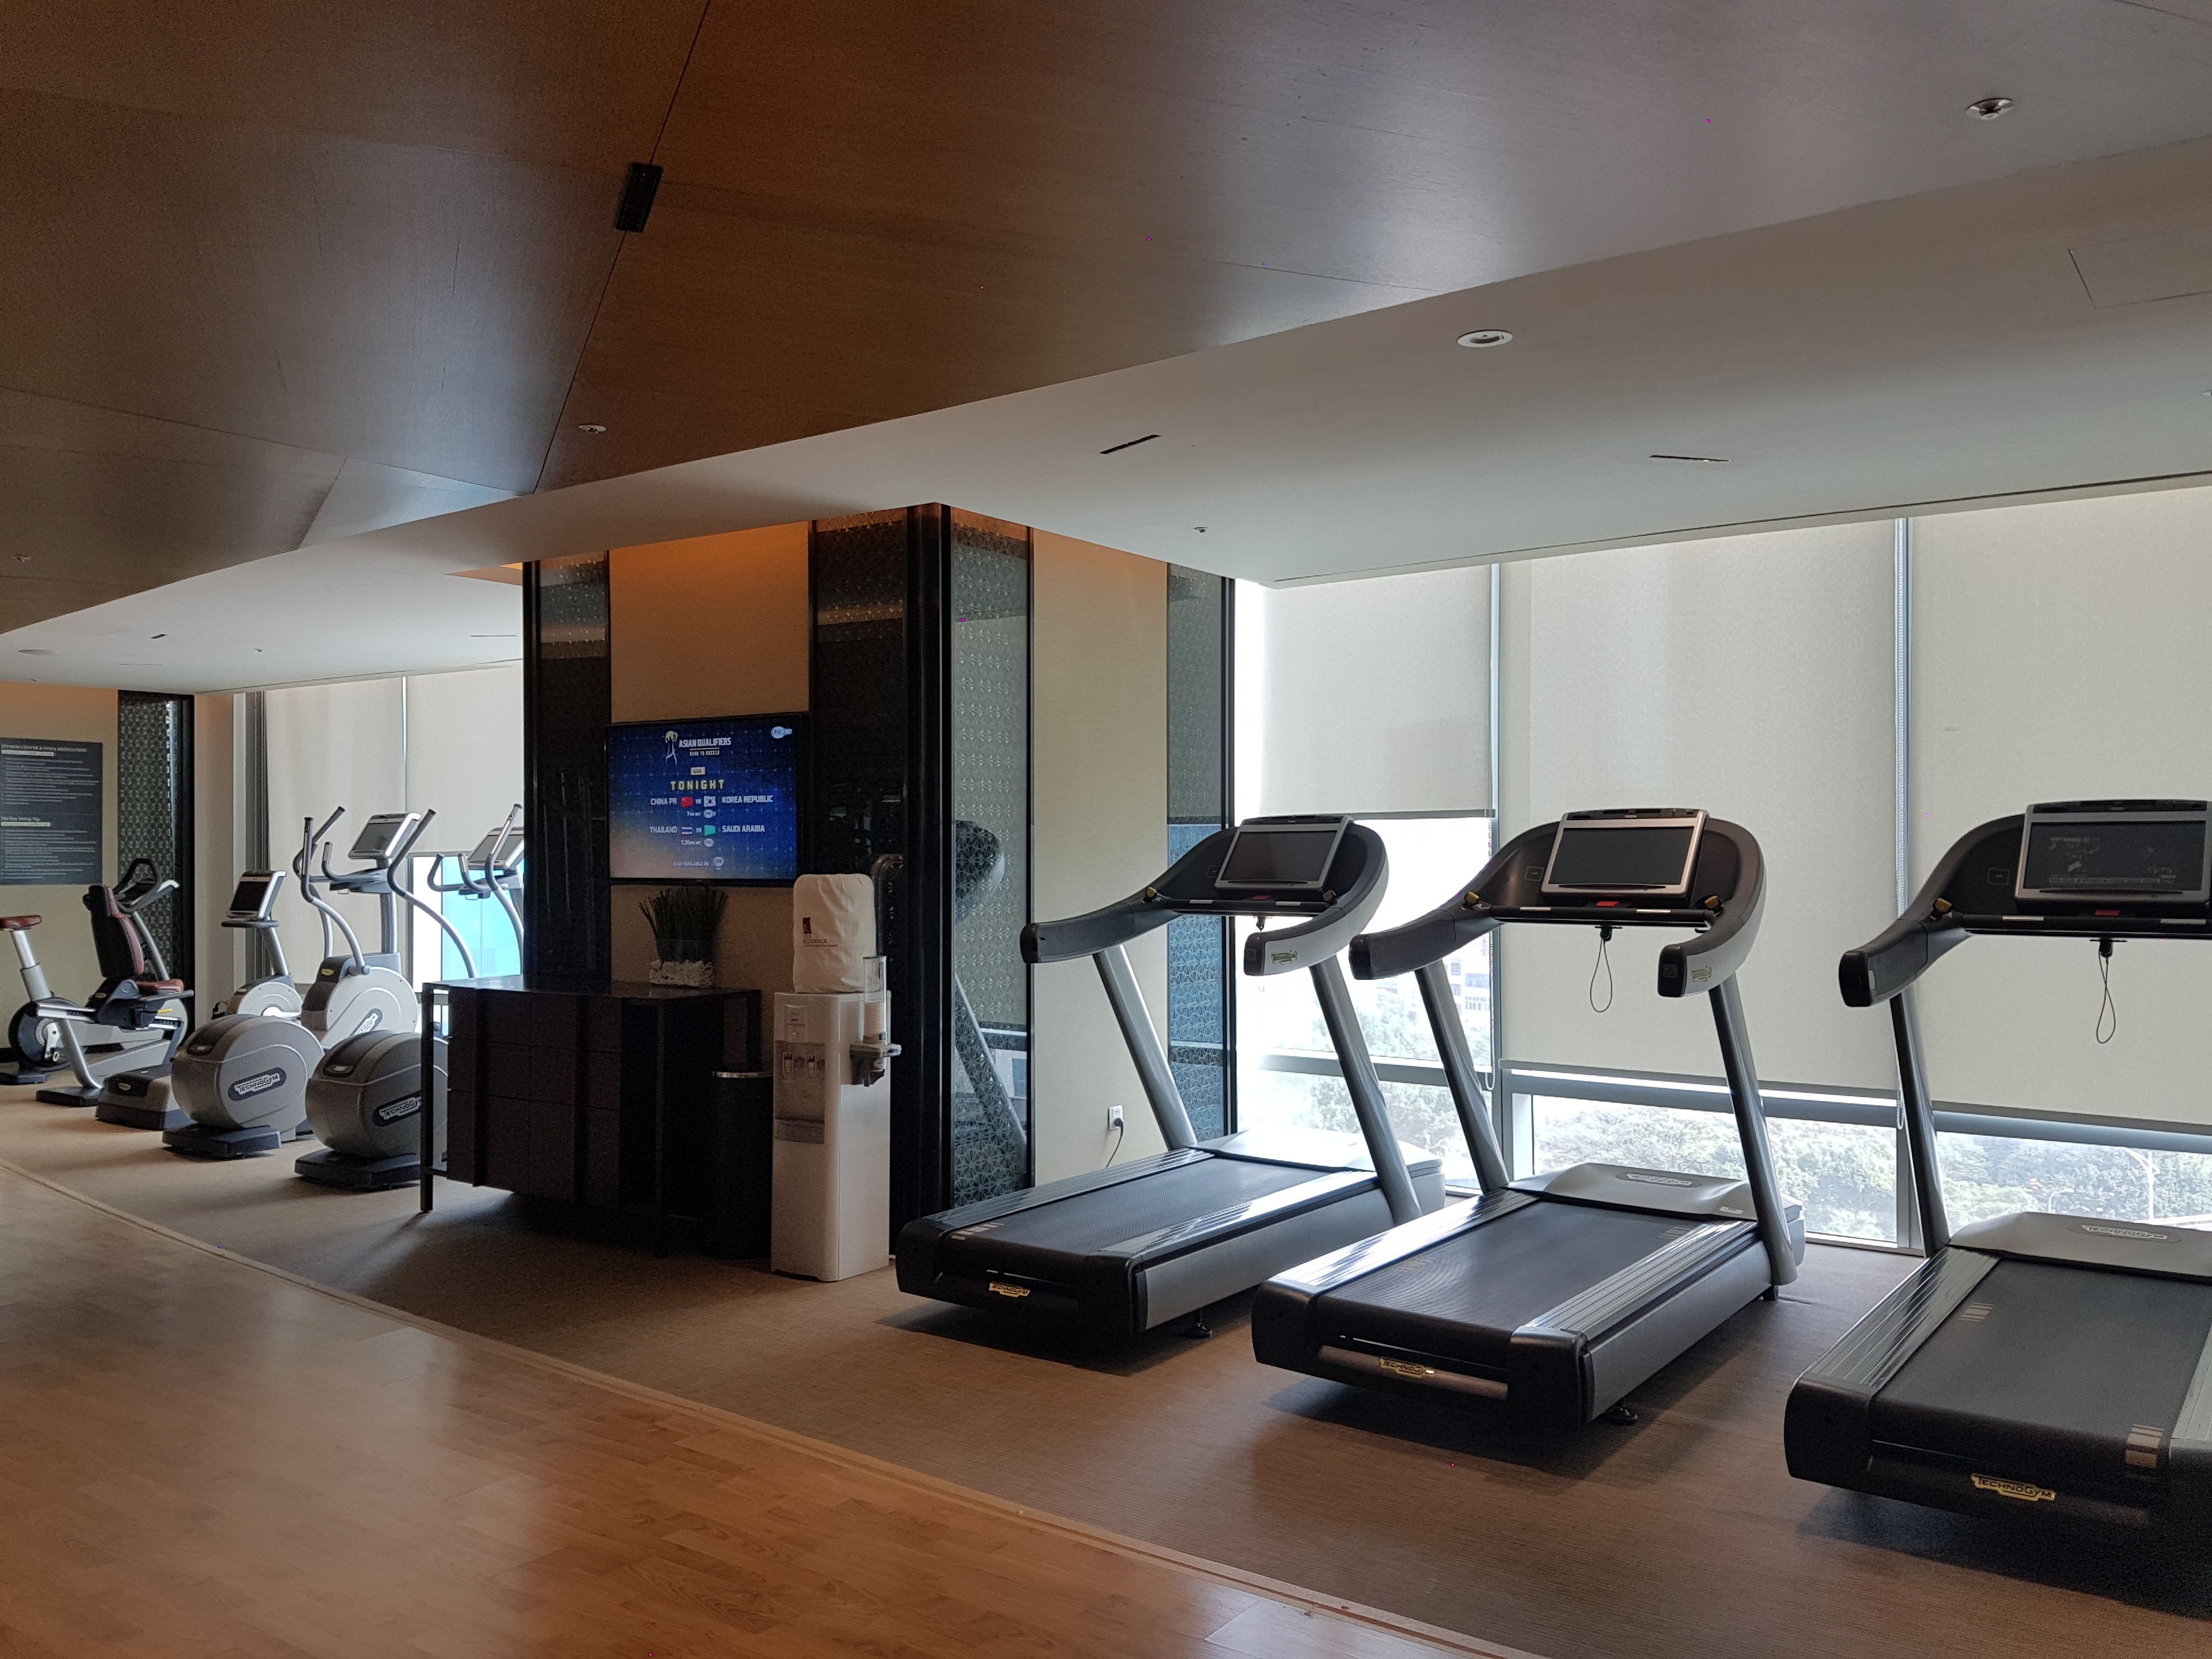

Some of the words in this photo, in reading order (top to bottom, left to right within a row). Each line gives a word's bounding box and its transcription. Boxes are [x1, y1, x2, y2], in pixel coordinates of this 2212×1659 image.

[679, 740, 697, 748] ASIAN
[697, 737, 732, 747] QUALIFIERS
[670, 779, 725, 791] TONIGHT
[743, 795, 774, 803] REPUBLIC
[722, 825, 741, 833] SAUDI
[236, 1075, 278, 1093] TECHNOGYM
[1974, 1475, 2051, 1497] TECHNOGYM
